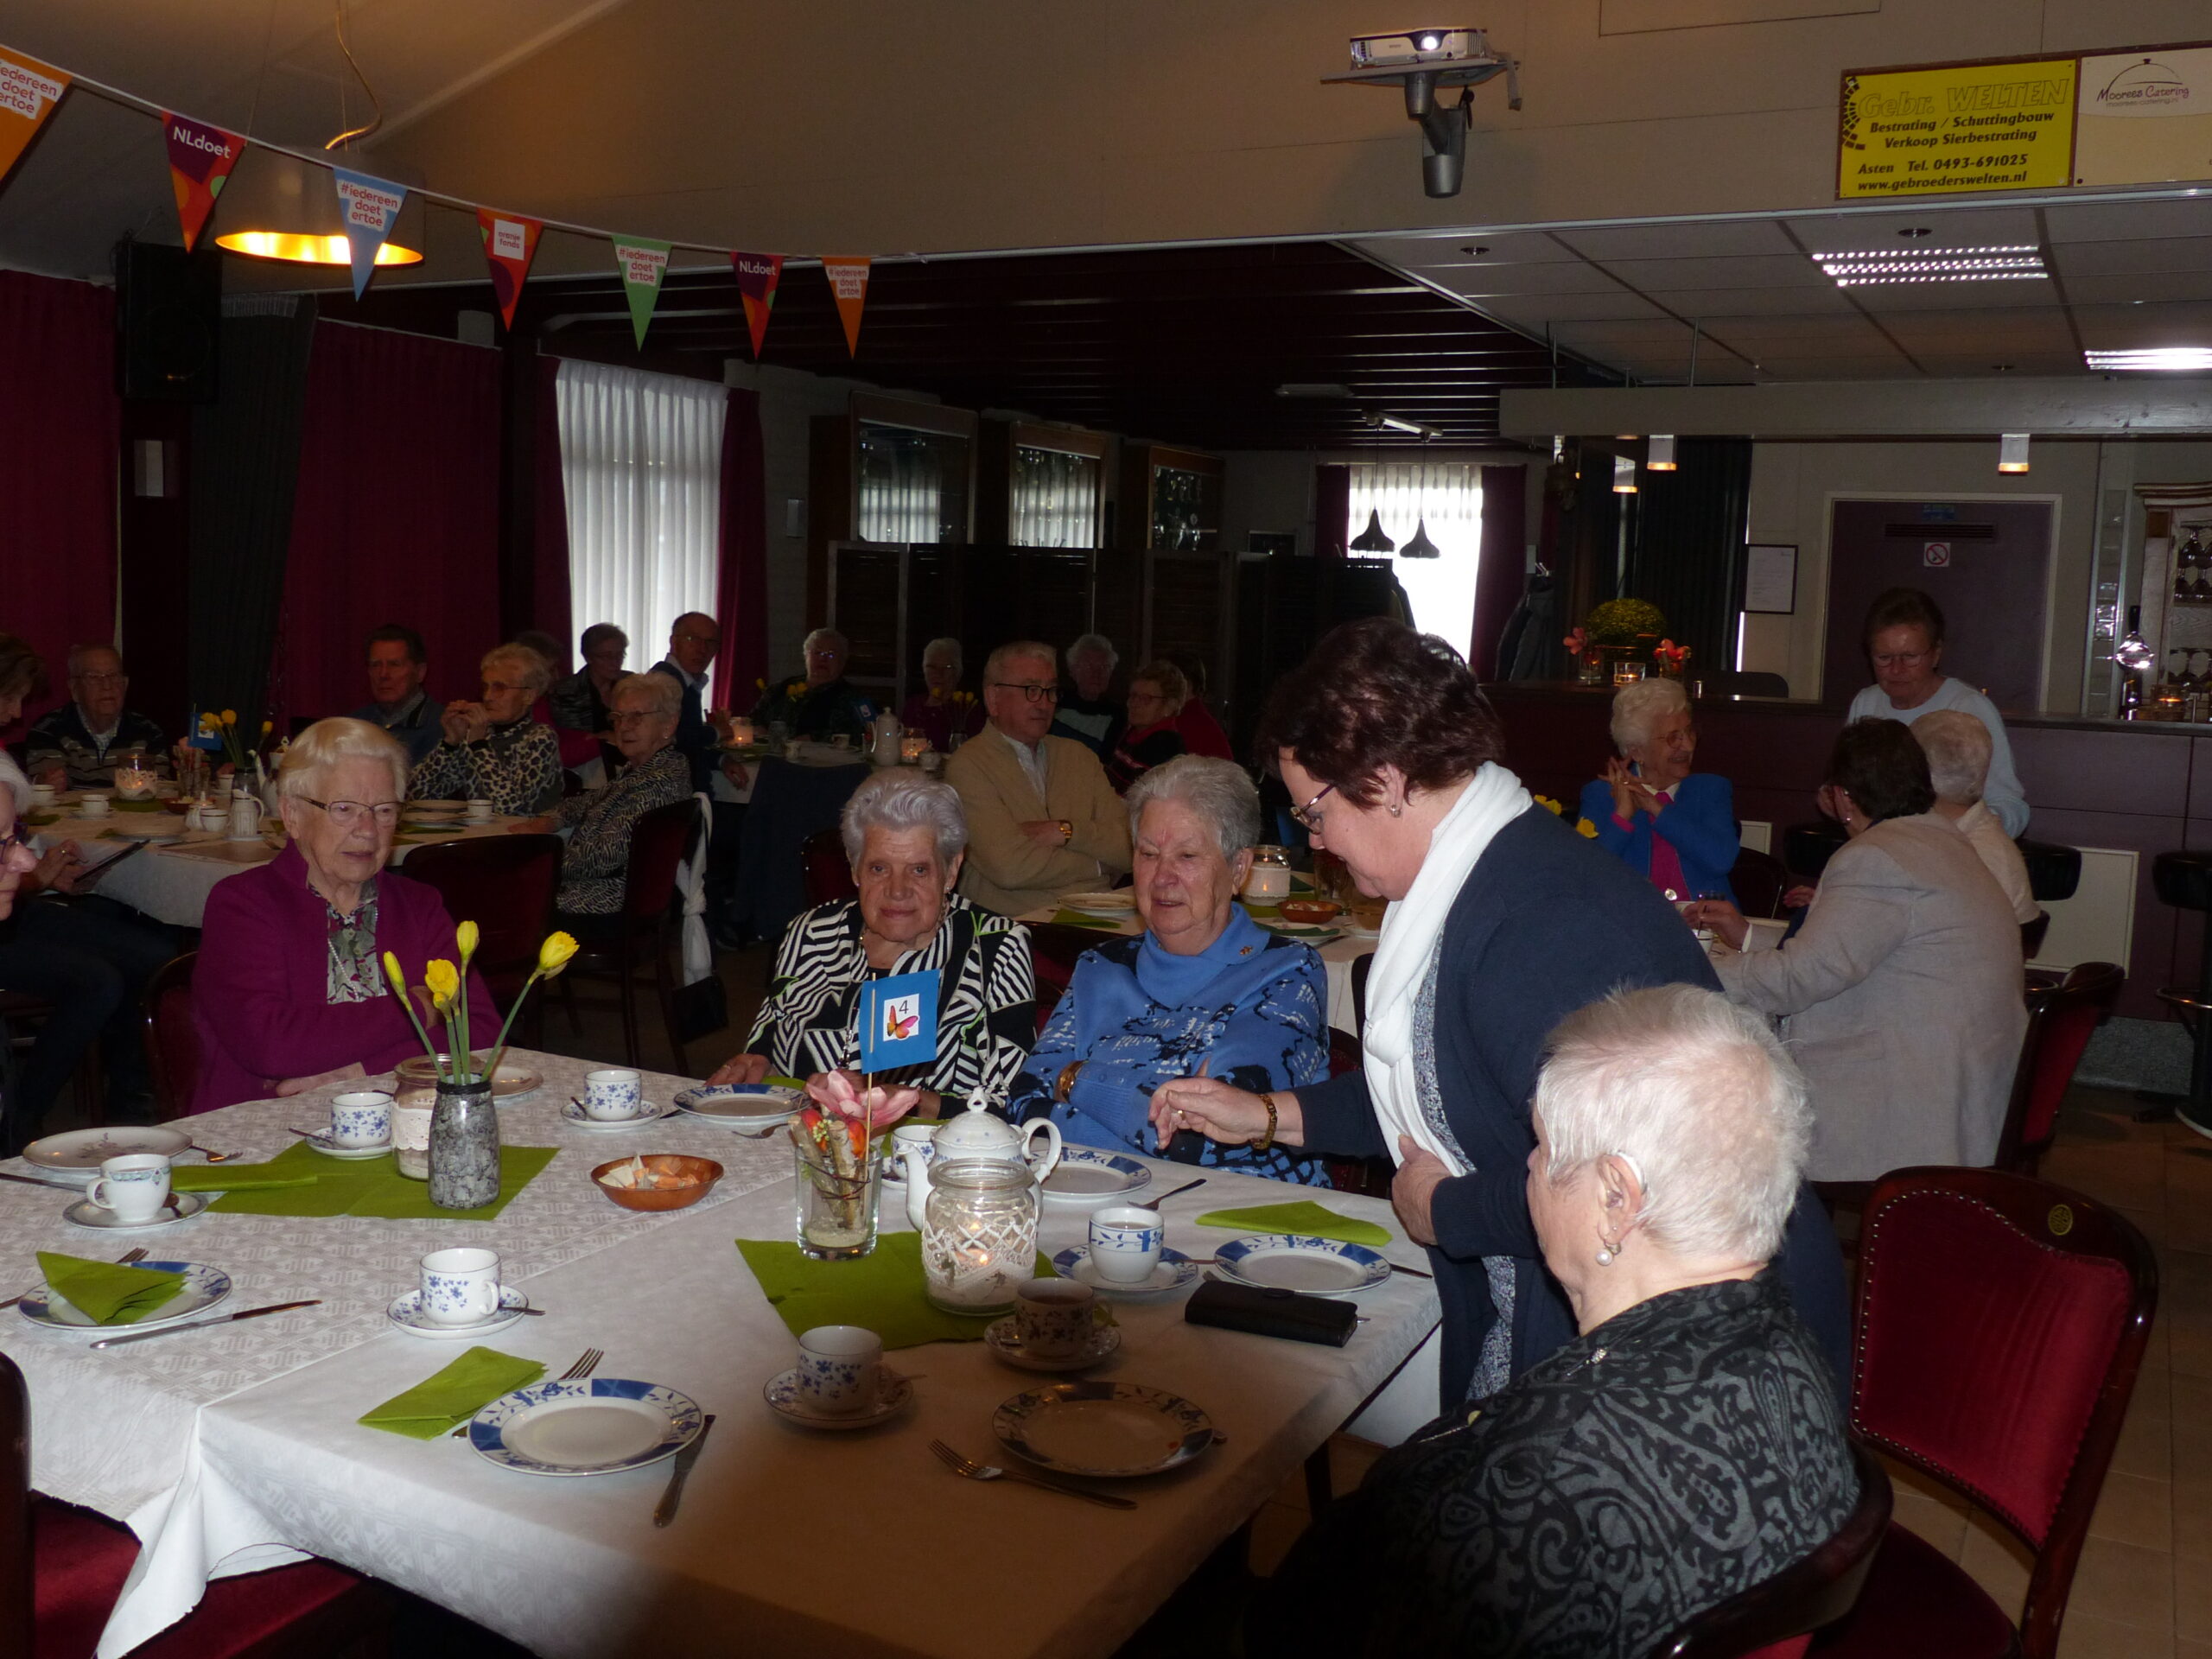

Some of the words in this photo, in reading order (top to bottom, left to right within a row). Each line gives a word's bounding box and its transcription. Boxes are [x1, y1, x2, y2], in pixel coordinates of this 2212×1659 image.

[0, 67, 57, 96] edereen
[2, 79, 35, 101] doet
[1859, 89, 1936, 118] Gebr.
[1947, 78, 2070, 112] WELTEN
[2096, 88, 2144, 102] Moorees
[2145, 86, 2190, 99] Catering
[1870, 119, 1936, 133] Bestrating
[1941, 118, 1949, 129] /
[1953, 111, 2055, 129] Schuttingbouw
[173, 125, 232, 159] NLdoet
[1885, 137, 1938, 149] Verkoop
[1942, 130, 2037, 145] Sierbestrating
[1858, 162, 1894, 175] Asten
[1907, 159, 1929, 172] Tel.
[1933, 153, 2029, 170] 0493-691025
[1858, 170, 2028, 191] www.gebroederswelten.nl
[341, 182, 397, 208] #iedereen
[355, 200, 381, 215] doet
[352, 212, 383, 226] ertoe
[620, 247, 665, 264] #iedereen
[631, 260, 652, 272] doet
[739, 260, 777, 276] NLdoet
[829, 267, 868, 277] #iedereen
[629, 272, 655, 283] ertoe
[840, 278, 858, 287] doet
[839, 287, 860, 296] ertoe
[899, 1000, 909, 1014] 4
